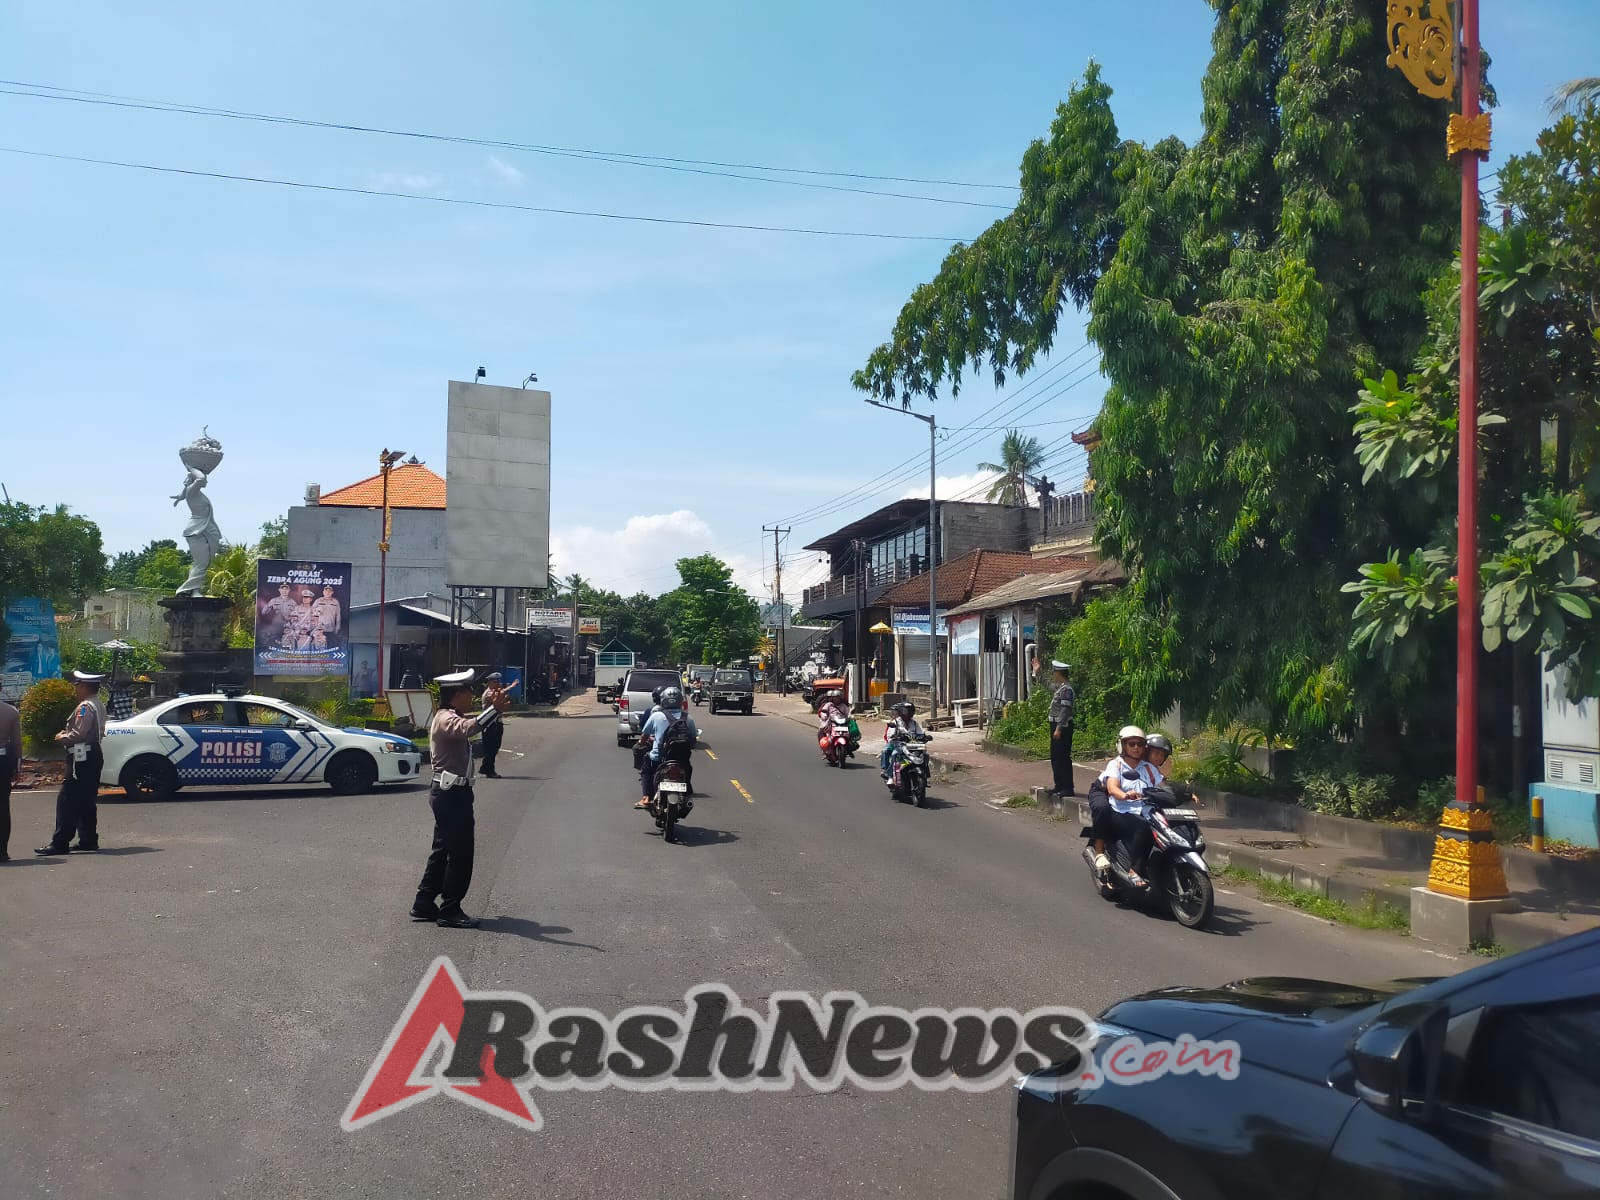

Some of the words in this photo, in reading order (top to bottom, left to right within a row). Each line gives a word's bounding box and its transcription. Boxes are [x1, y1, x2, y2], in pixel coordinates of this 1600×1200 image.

[287, 569, 321, 578] OPERASI
[267, 575, 291, 583] ZEBRA
[293, 576, 321, 584] AGUNG
[201, 741, 262, 757] POLISI
